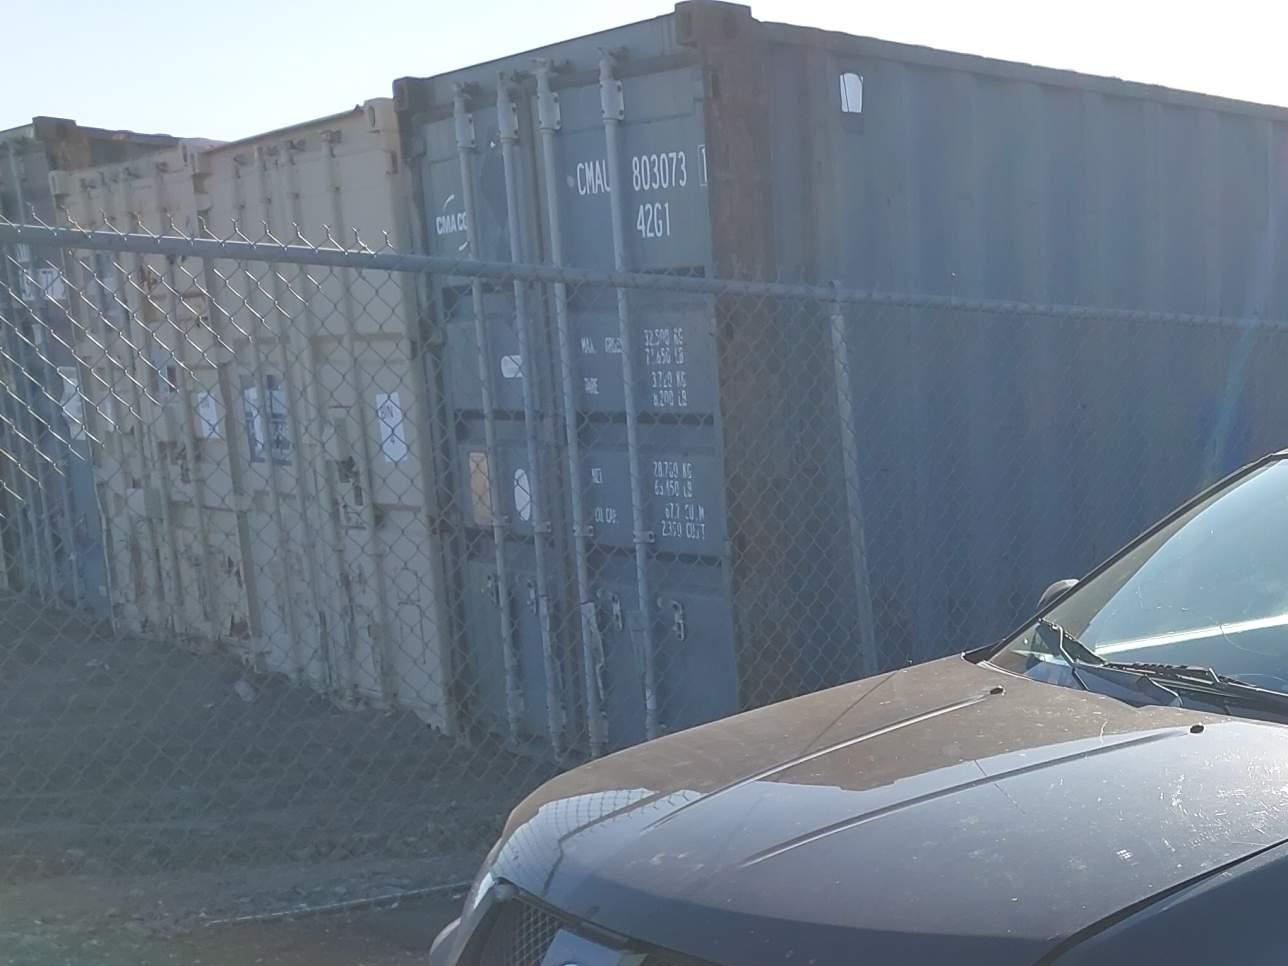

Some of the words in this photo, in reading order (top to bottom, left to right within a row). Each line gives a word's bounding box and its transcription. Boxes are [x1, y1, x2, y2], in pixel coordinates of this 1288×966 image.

[631, 151, 688, 191] 803073
[436, 214, 458, 235] CMA
[636, 201, 671, 239] 42G1
